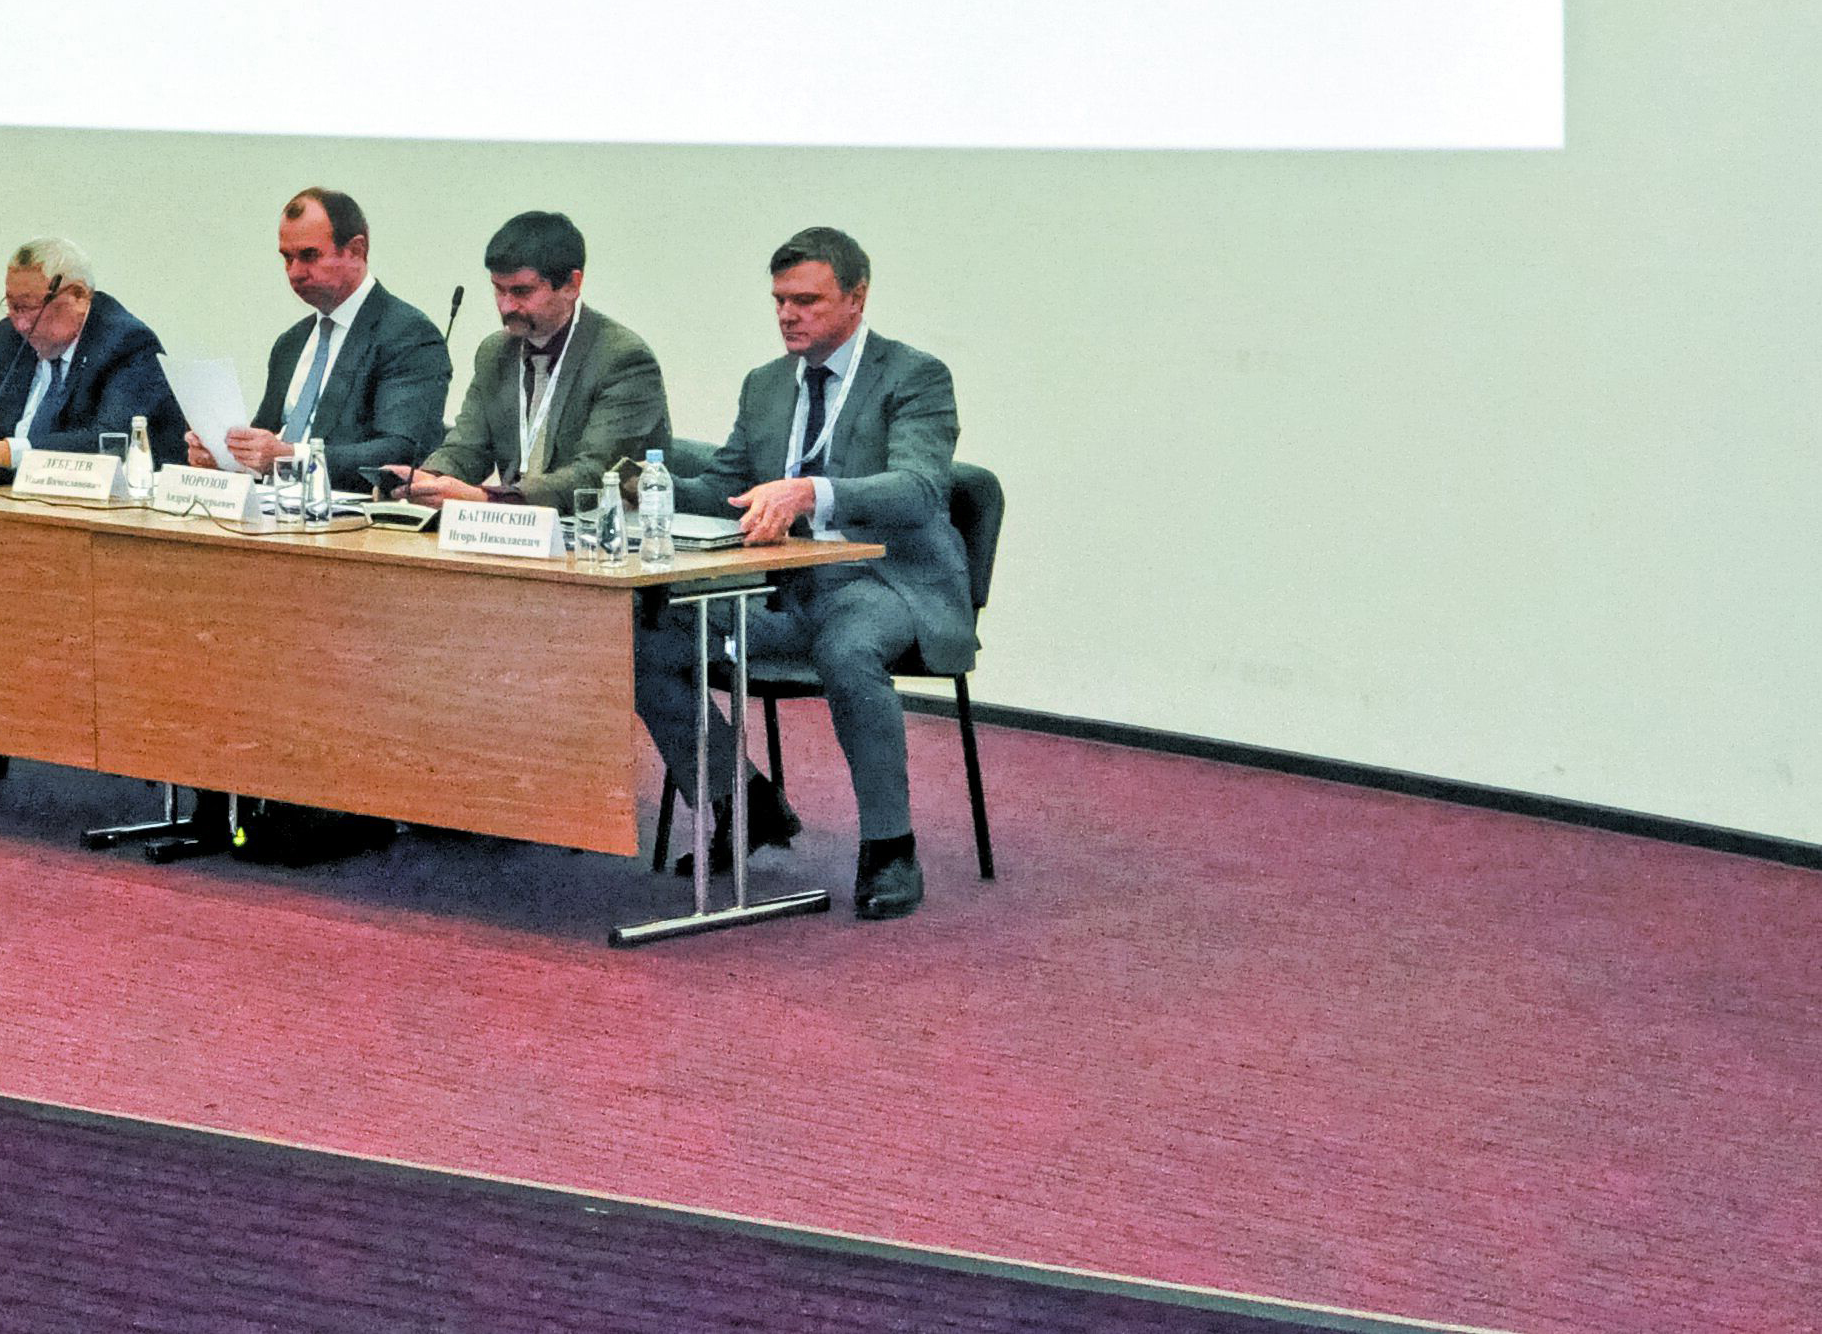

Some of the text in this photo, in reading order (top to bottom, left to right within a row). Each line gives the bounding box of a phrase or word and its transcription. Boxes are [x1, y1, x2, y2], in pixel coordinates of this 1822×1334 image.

[181, 473, 229, 490] МОРОЗОВ
[457, 508, 537, 527] БАГИНСКИЙ
[448, 528, 541, 548] Игорь Николаевич
